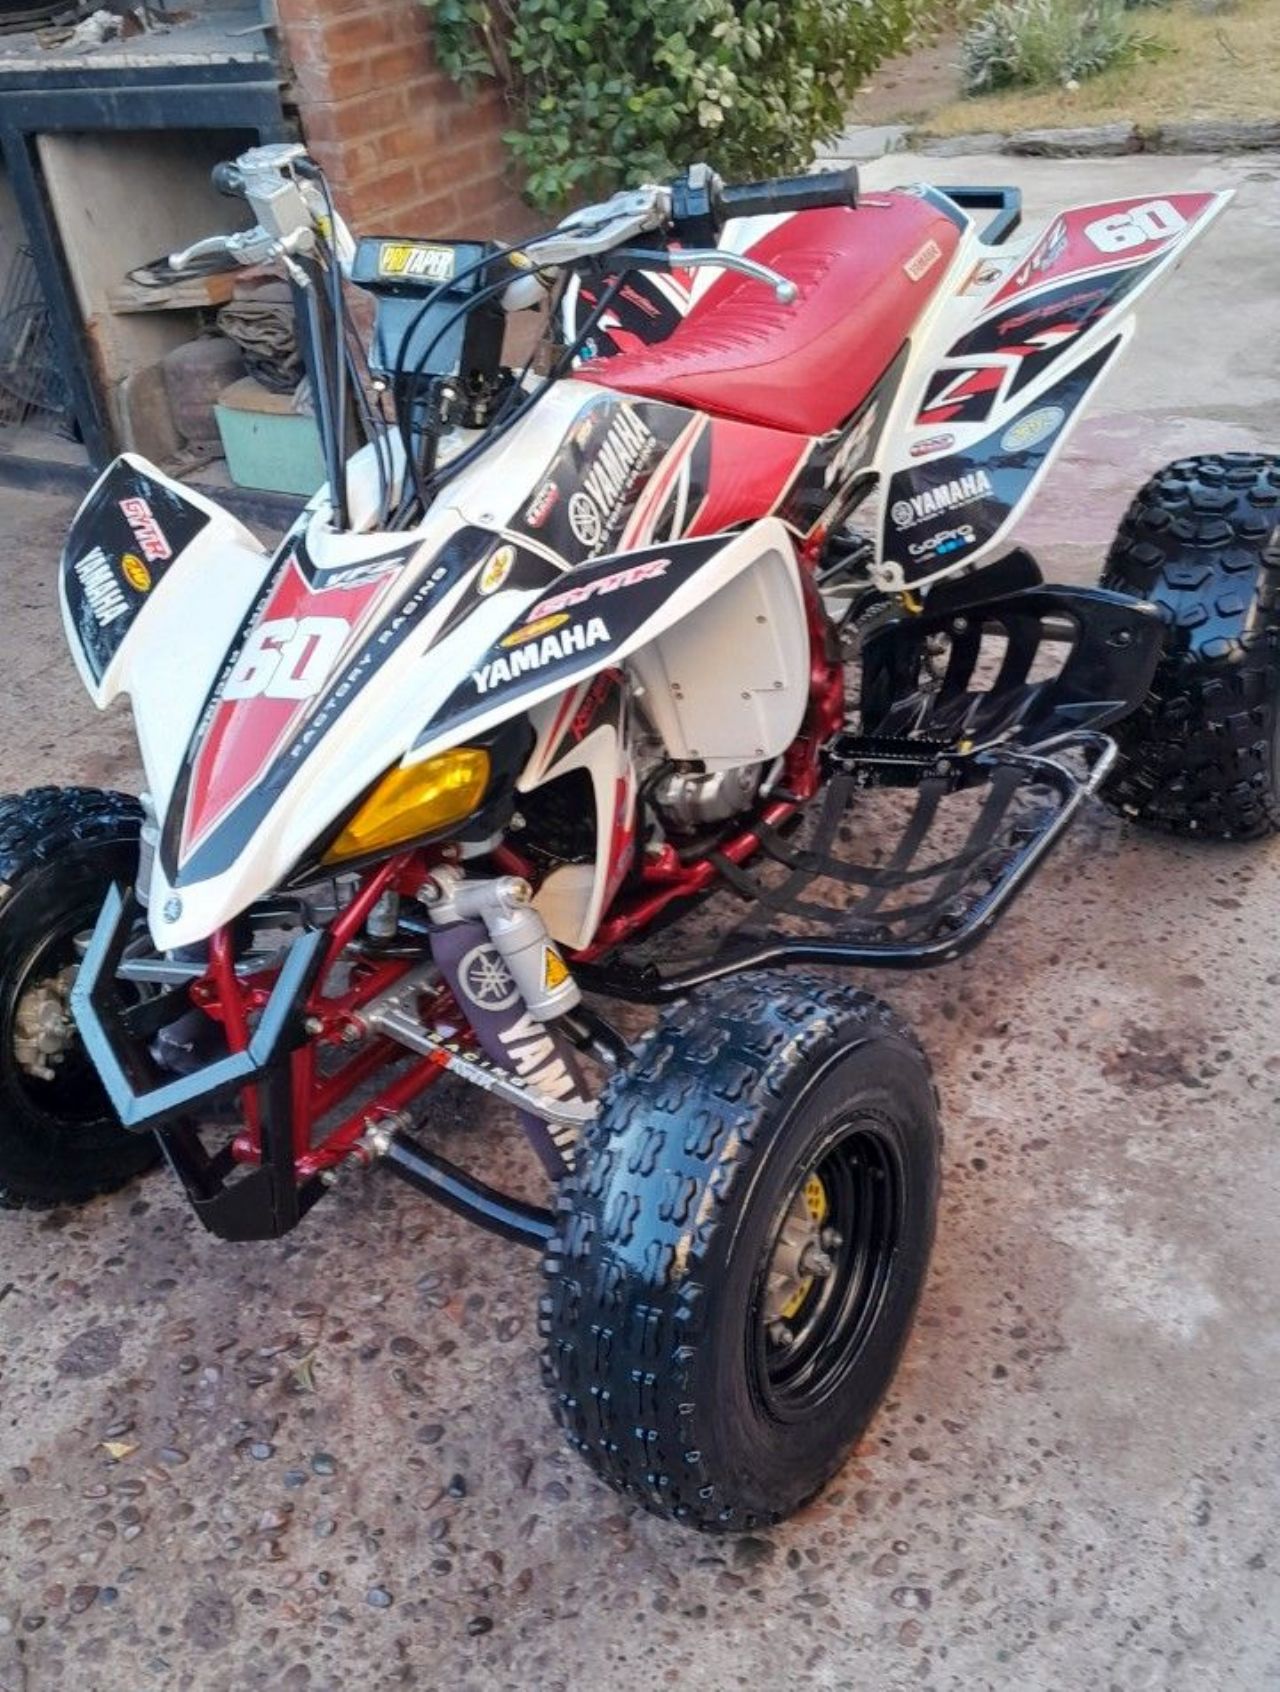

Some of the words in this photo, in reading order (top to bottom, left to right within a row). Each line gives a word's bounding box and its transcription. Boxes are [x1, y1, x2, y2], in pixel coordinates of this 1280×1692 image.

[1084, 199, 1188, 253] 60
[584, 402, 652, 517] YAMAHA
[909, 469, 991, 517] YAMAHA
[73, 545, 131, 627] YAMAHA
[221, 615, 352, 700] 60
[290, 651, 374, 758] FACTORY
[377, 566, 448, 646] RACING
[471, 616, 611, 694] YAMAHA
